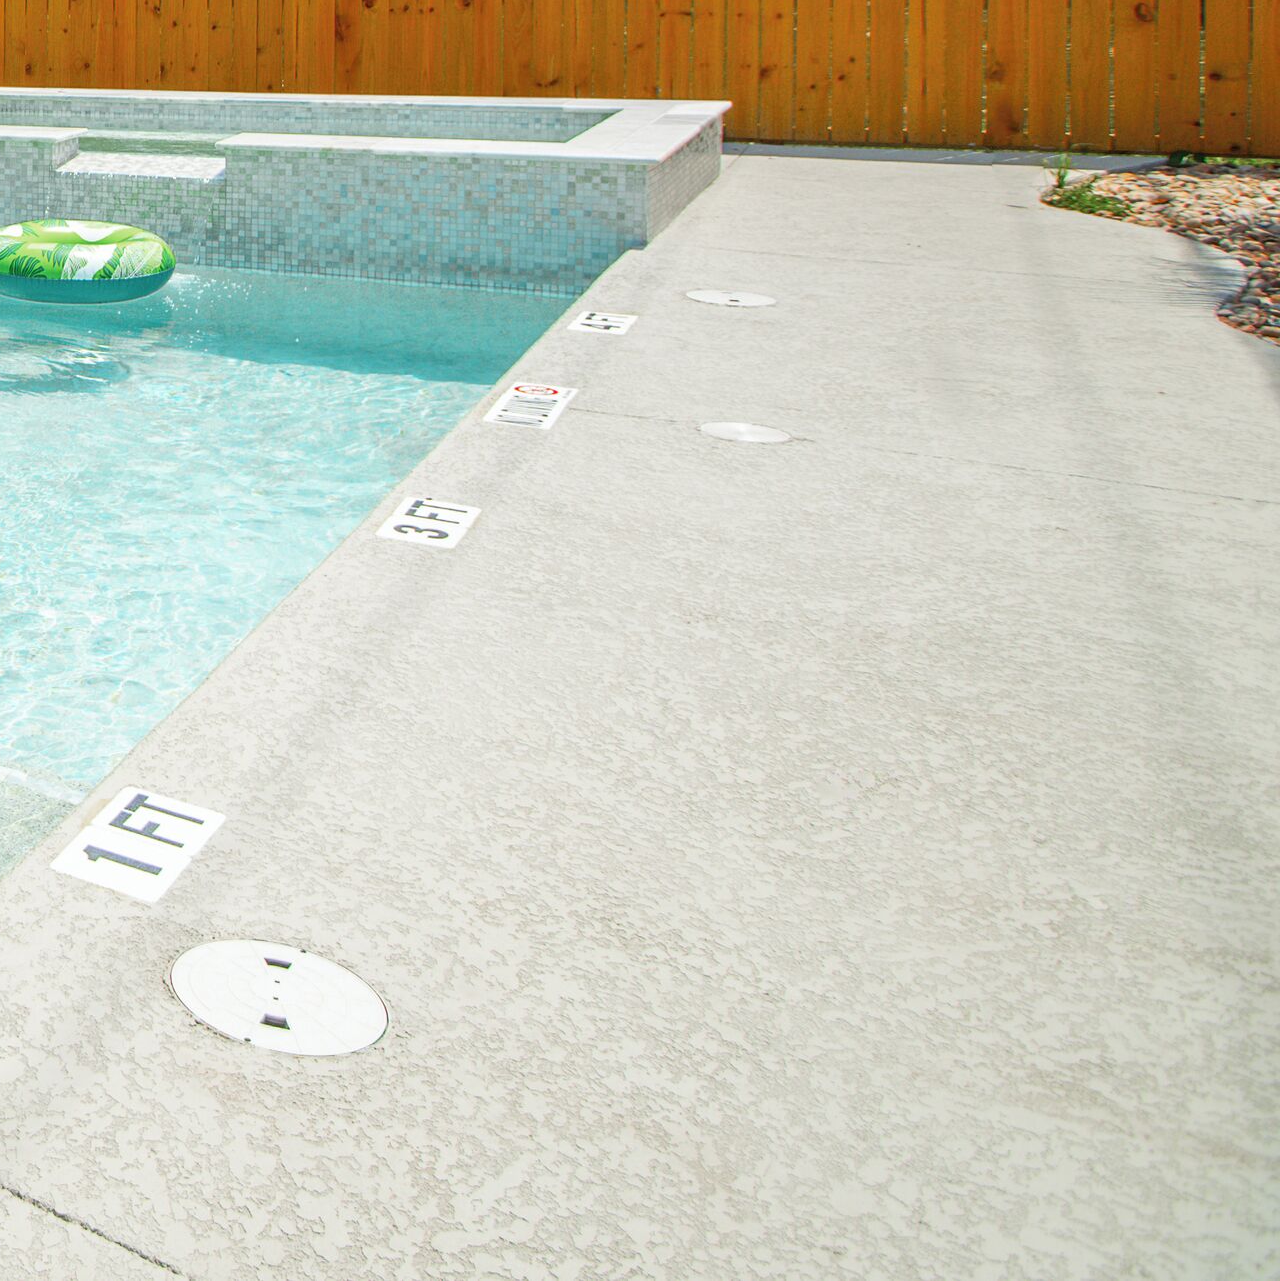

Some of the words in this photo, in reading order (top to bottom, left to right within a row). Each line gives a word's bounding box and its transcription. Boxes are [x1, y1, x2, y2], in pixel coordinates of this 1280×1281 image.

[405, 500, 468, 524] FT
[393, 524, 449, 539] 3
[109, 793, 205, 848] FT
[83, 844, 162, 876] 1
